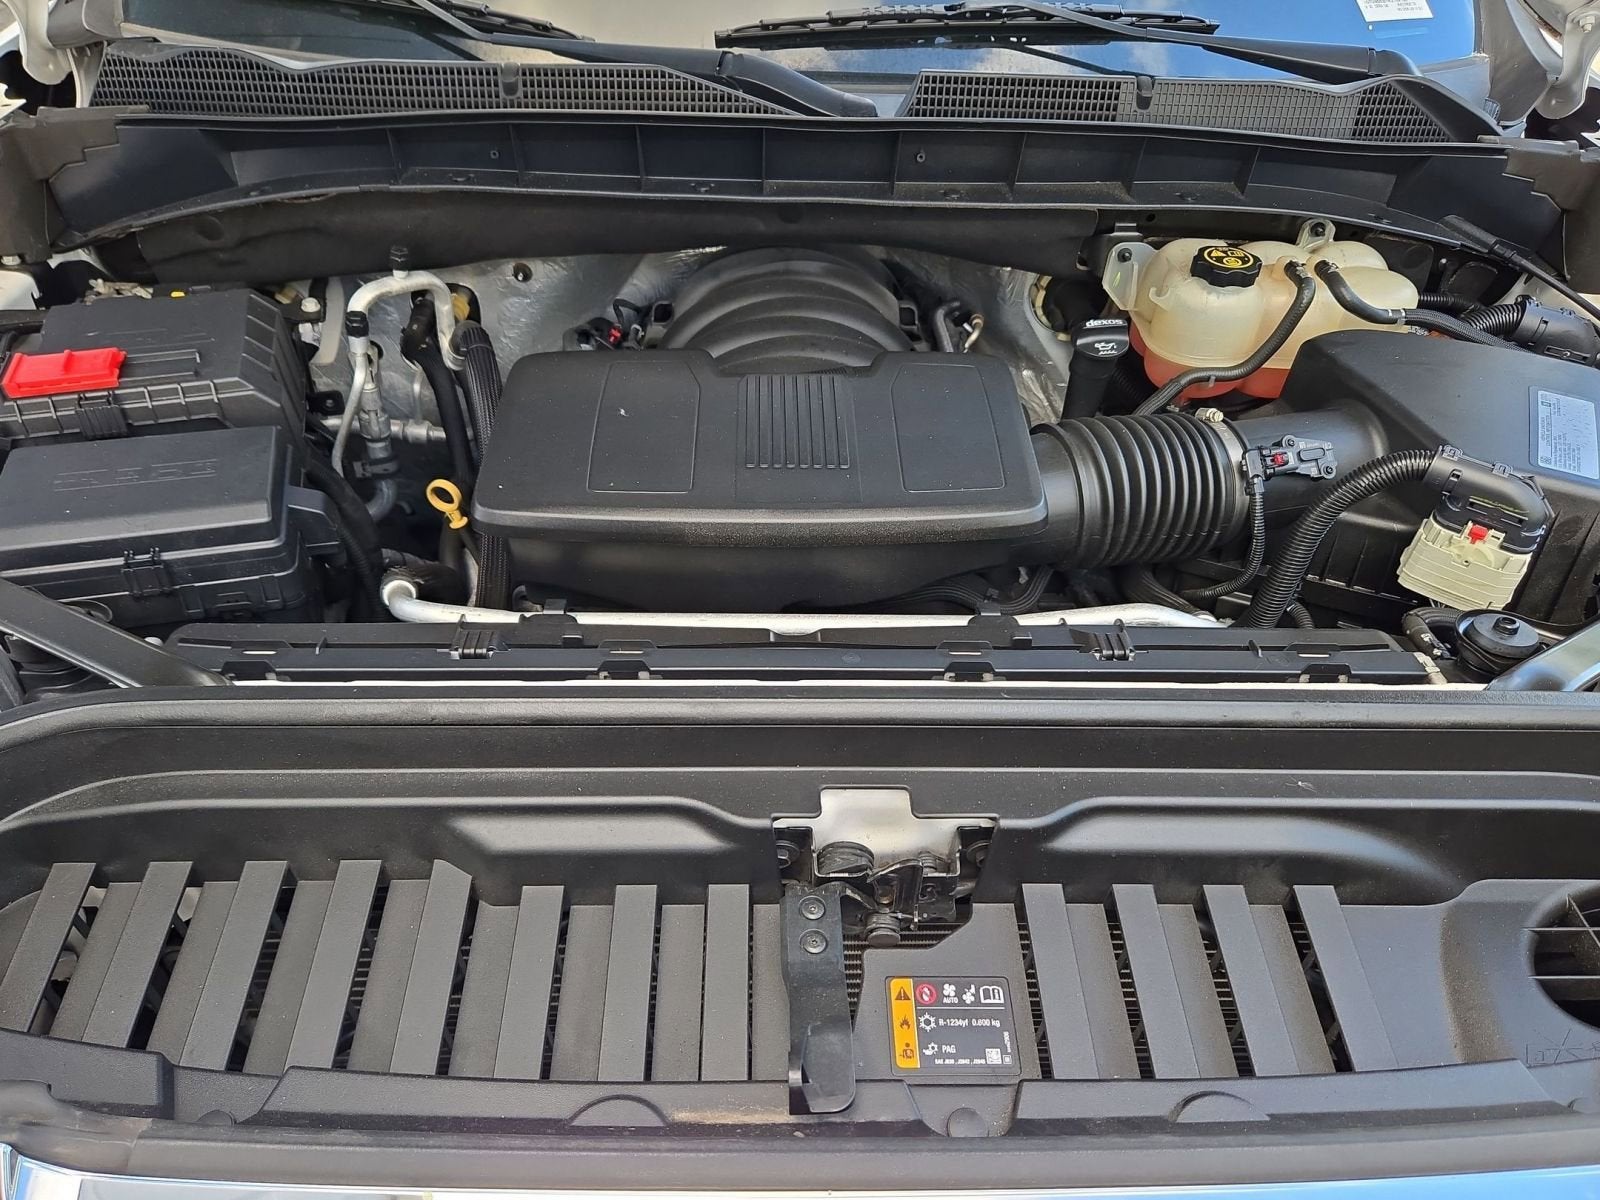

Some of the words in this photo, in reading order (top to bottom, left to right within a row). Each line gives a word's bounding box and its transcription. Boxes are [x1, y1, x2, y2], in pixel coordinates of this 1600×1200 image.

[1086, 319, 1123, 327] dexos
[938, 1018, 968, 1028] R-1234yf
[991, 1018, 1001, 1028] kg
[942, 1045, 956, 1054] PAG
